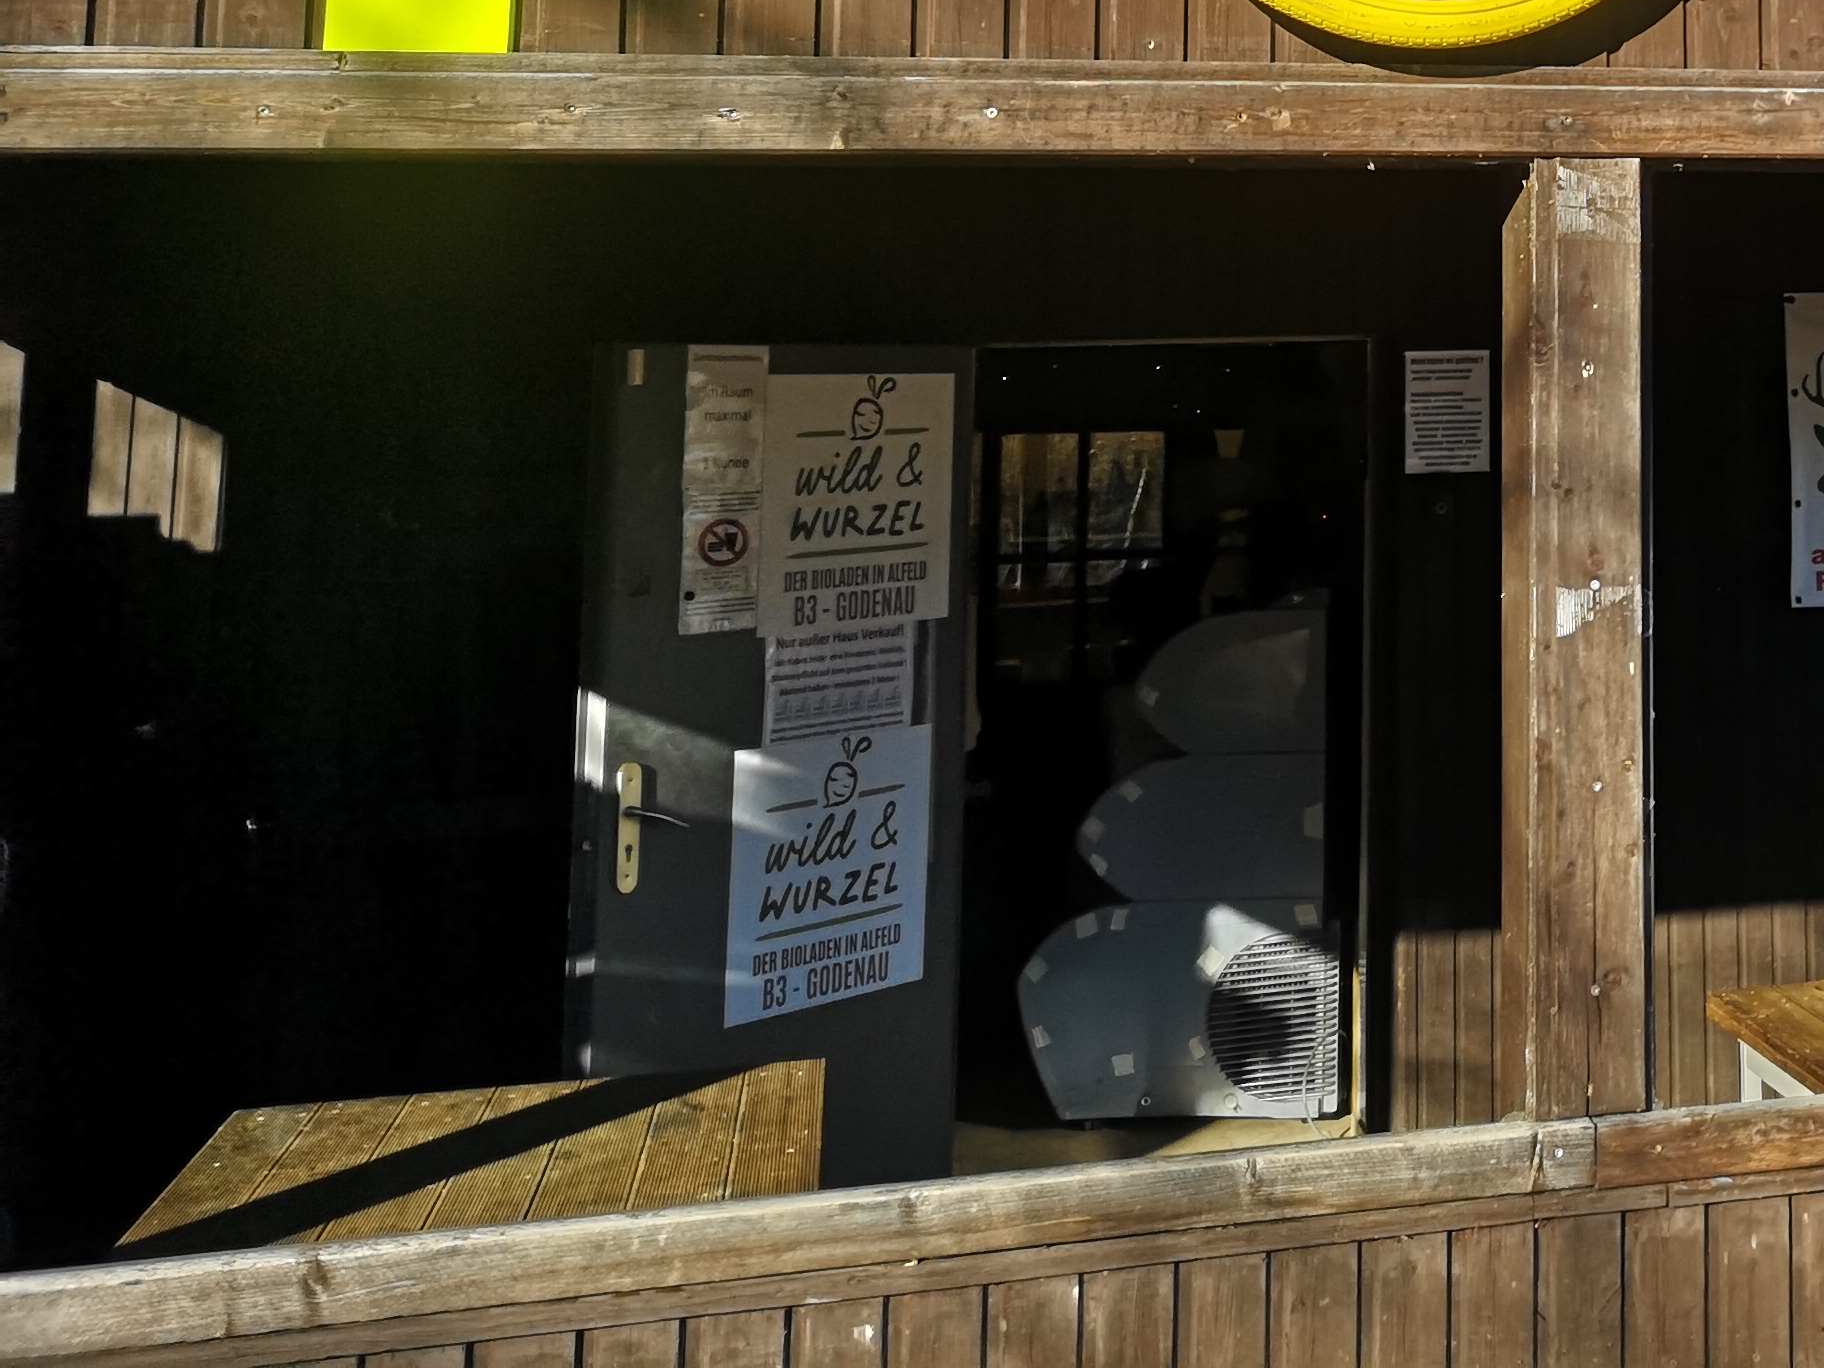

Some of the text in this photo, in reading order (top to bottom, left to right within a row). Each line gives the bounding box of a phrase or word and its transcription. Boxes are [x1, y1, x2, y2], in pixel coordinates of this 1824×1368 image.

[795, 442, 923, 496] wild &
[790, 500, 925, 541] WURZEL
[783, 560, 927, 593] DER BIOLADEN IN ALFELD
[794, 595, 818, 626] B3
[836, 585, 916, 622] GODENAU
[765, 800, 899, 875] wild &
[758, 861, 899, 923] WURZEL
[752, 923, 901, 977] DER BIOLADEN IN ALFELD
[762, 975, 787, 1011] B3
[806, 951, 890, 1001] GODENAU
